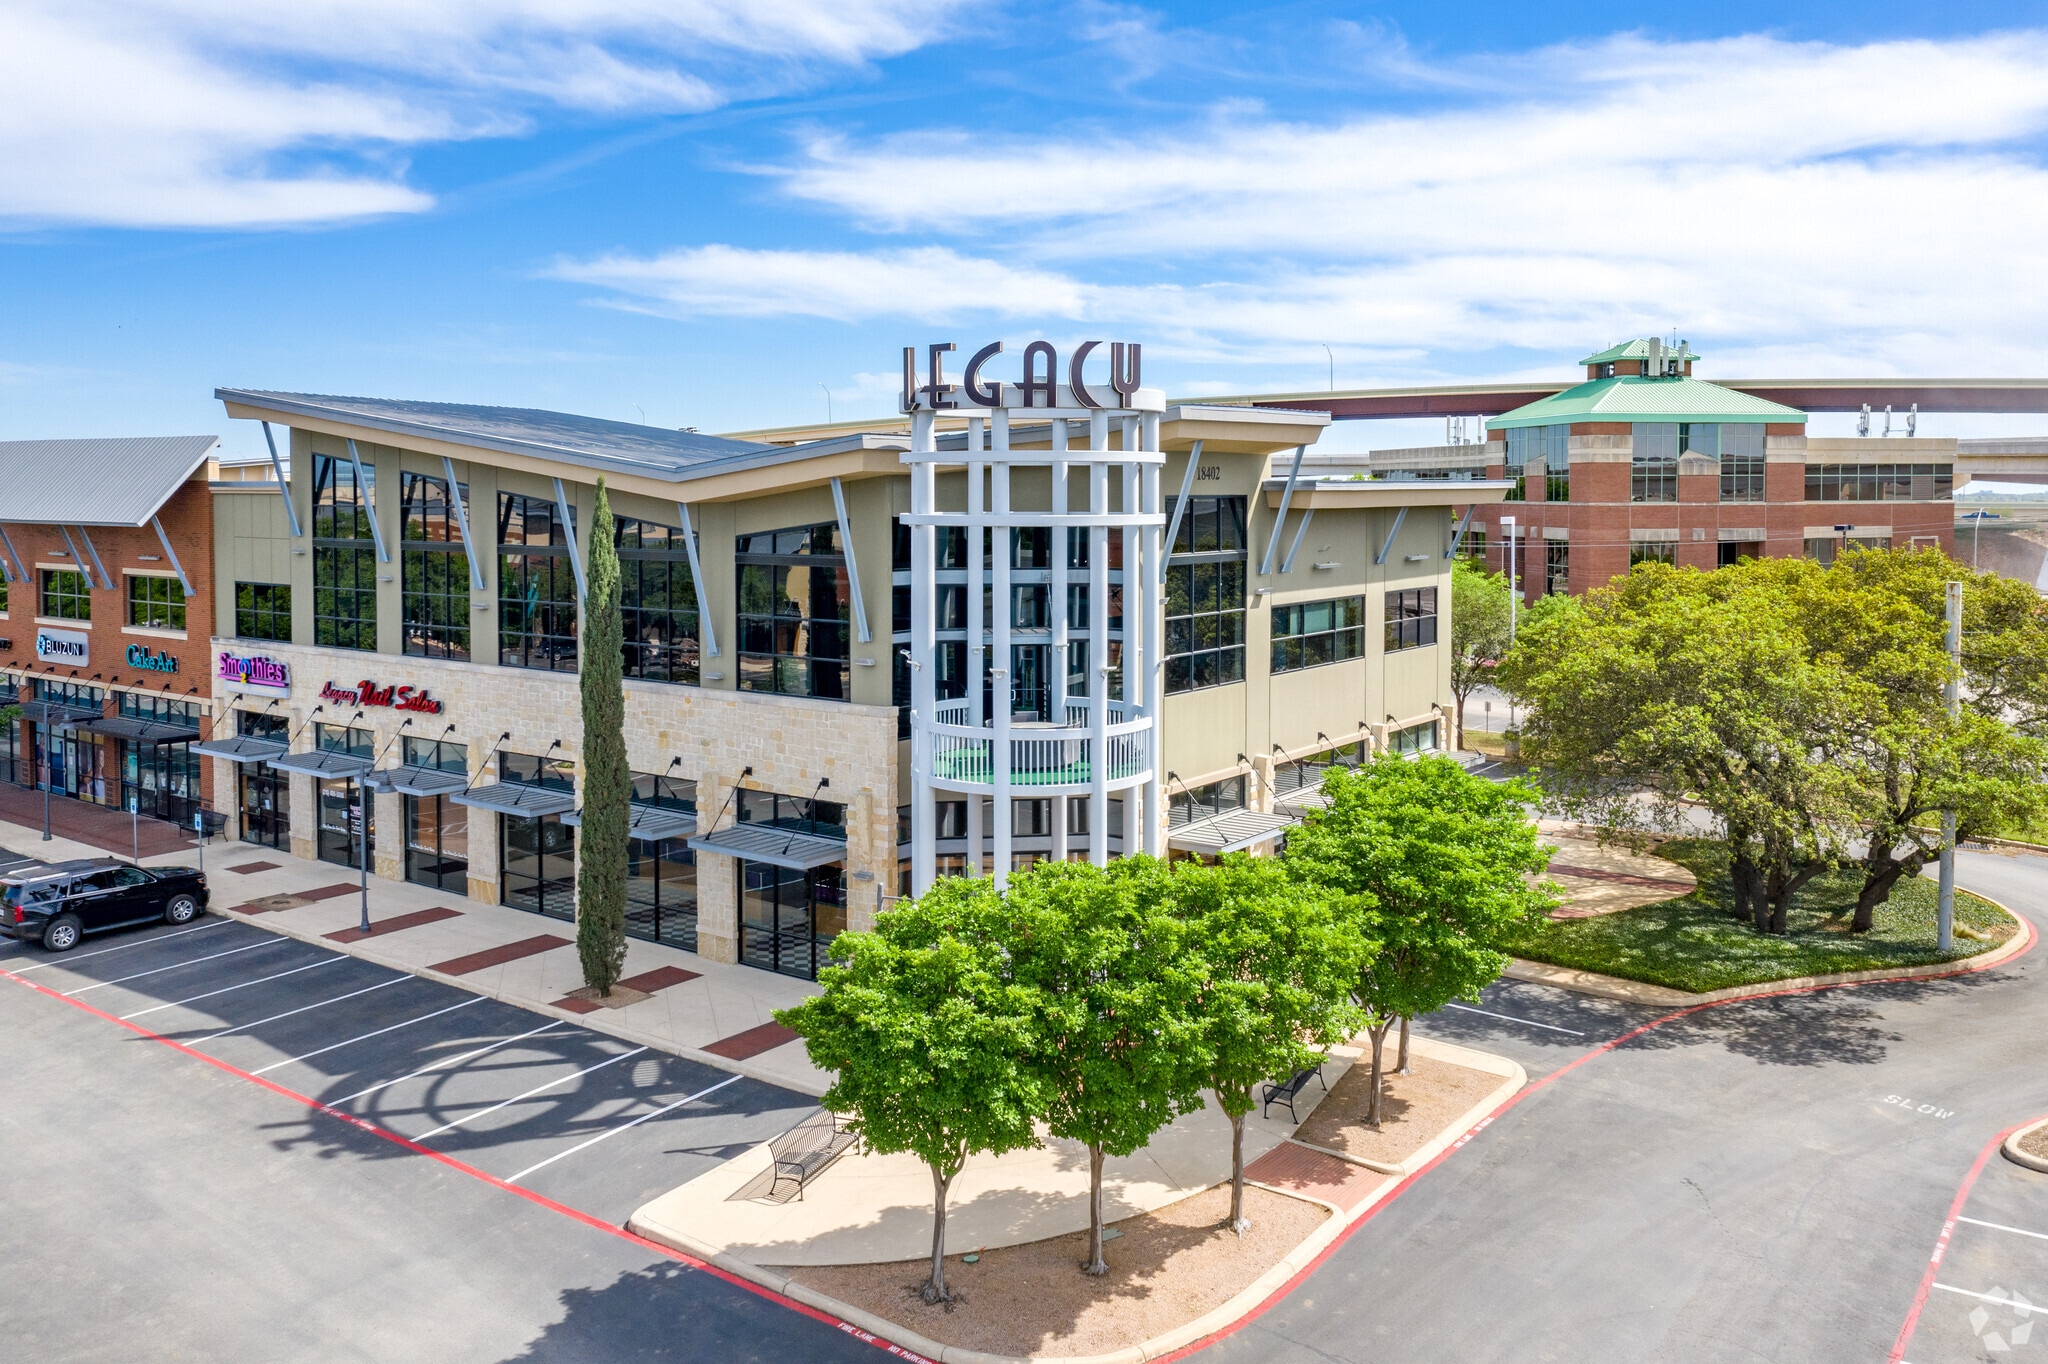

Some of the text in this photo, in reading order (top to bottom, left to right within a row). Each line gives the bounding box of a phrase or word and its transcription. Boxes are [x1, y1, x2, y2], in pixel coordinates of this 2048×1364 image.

[903, 340, 1142, 411] LEGACY
[1197, 466, 1220, 481] 18402
[46, 640, 83, 656] BLUZUN
[126, 645, 177, 673] Cake Art
[219, 652, 283, 682] Smoothies
[319, 680, 440, 715] Legacy Nail Salon
[1883, 1094, 1955, 1119] SLOW
[837, 1322, 856, 1334] FIRE
[854, 1330, 877, 1343] LANE
[887, 1345, 901, 1354] NO
